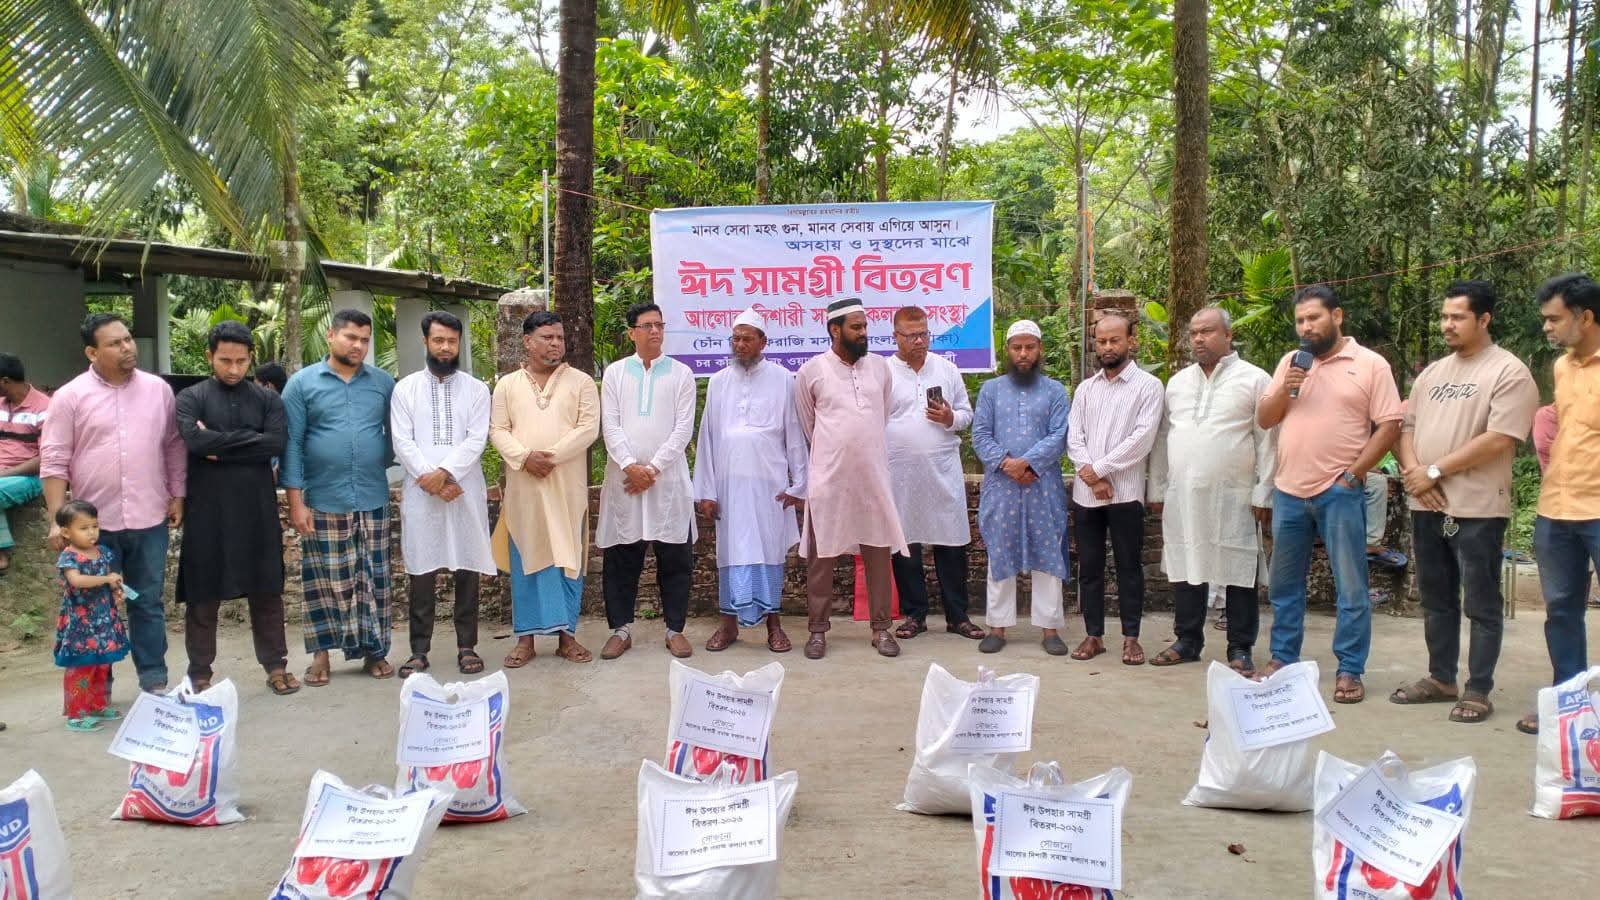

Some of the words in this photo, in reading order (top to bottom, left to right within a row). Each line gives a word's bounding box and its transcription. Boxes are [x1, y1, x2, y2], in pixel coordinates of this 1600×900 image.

[691, 223, 719, 237] মানব
[724, 223, 750, 236] সেবা
[753, 223, 778, 237] মহৎ
[807, 221, 837, 235] মানব
[840, 221, 875, 233] সেবায়
[879, 217, 914, 233] এগিয়ে
[785, 239, 841, 252] অসহায়
[849, 240, 862, 250] ও
[930, 235, 972, 249] মাঝে
[678, 260, 735, 297] ঈদ
[742, 255, 845, 298] সামগ্রী
[852, 254, 974, 295] বিতরণ
[1023, 803, 1035, 814] ঈদ
[1038, 805, 1065, 818] উপহার
[1066, 809, 1092, 821] সামগ্রী
